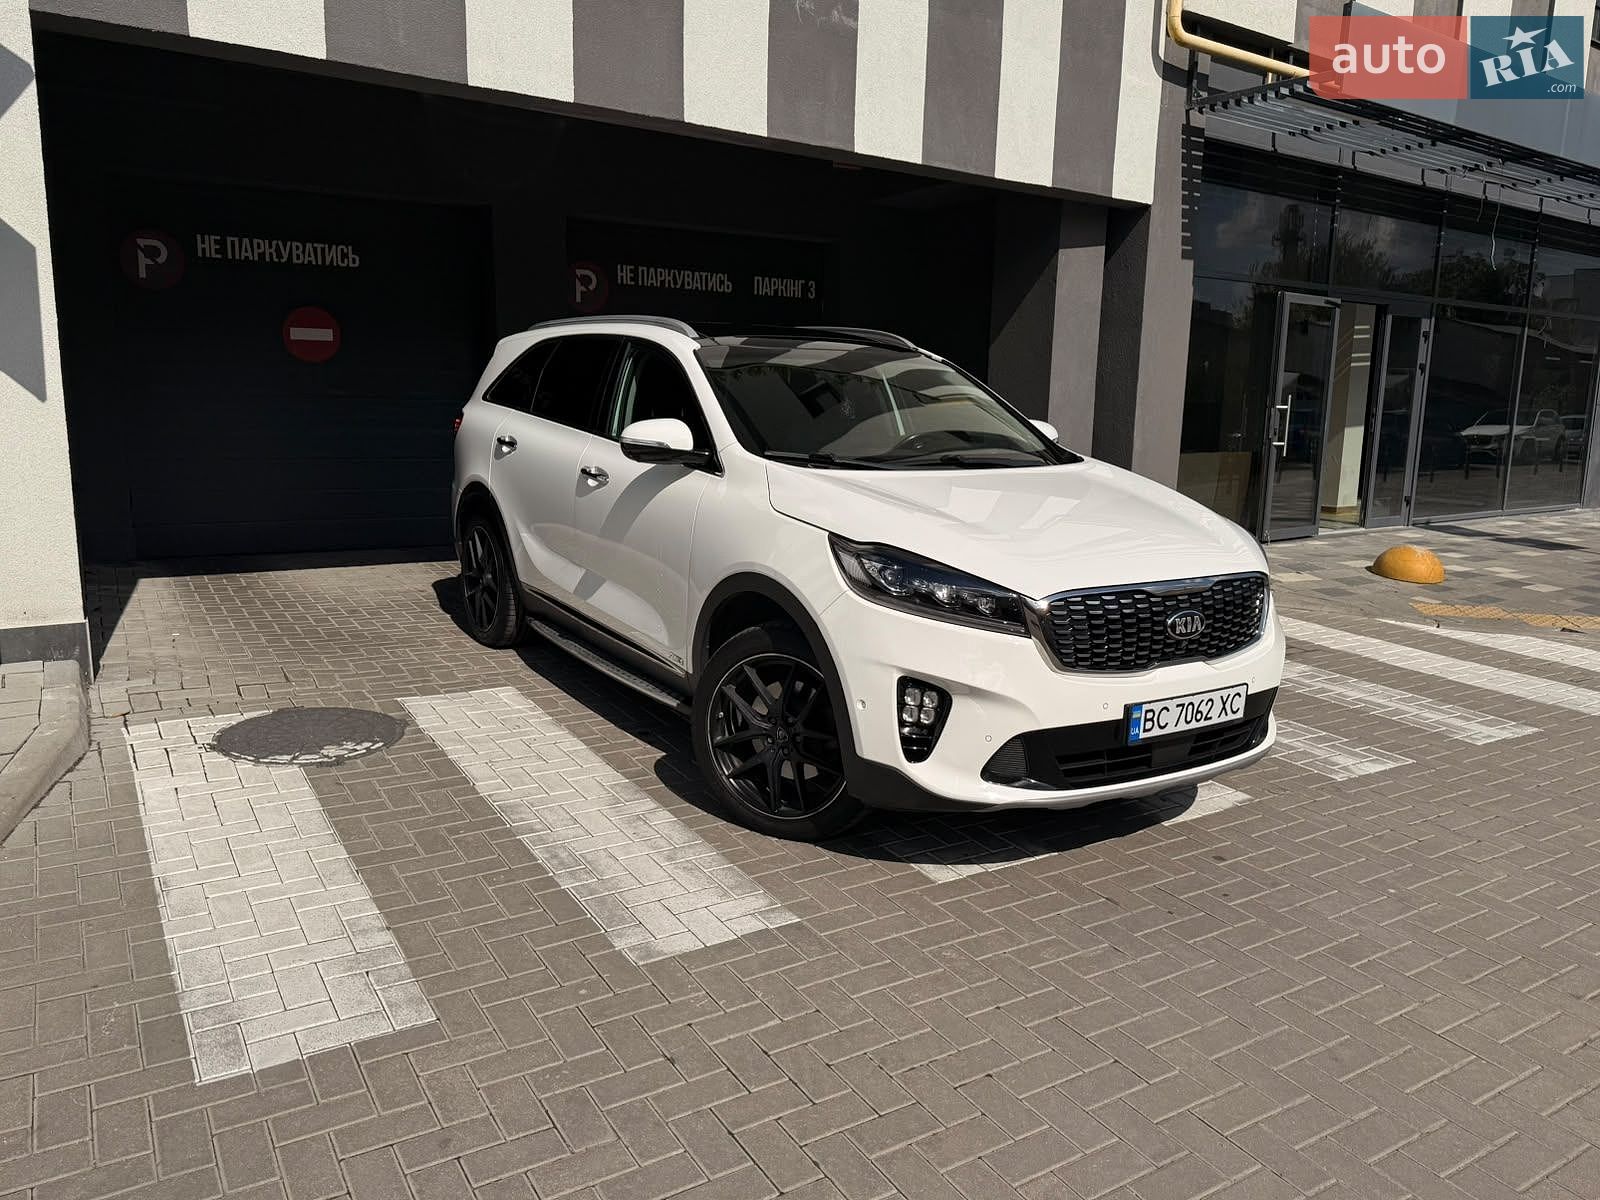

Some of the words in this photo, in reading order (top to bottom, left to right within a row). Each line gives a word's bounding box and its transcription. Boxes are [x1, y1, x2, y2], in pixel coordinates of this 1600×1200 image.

[196, 234, 222, 259] НЕ
[226, 236, 360, 268] ПАРКУВАТИСЬ
[617, 264, 635, 286] НЕ
[638, 266, 733, 293] ПАРКУВАТИСЬ
[753, 276, 806, 298] ПАРКІНГ
[808, 280, 816, 299] 3
[1175, 615, 1202, 635] KIA
[1142, 705, 1171, 734] BC
[1174, 697, 1215, 728] 7062
[1217, 692, 1242, 719] XC
